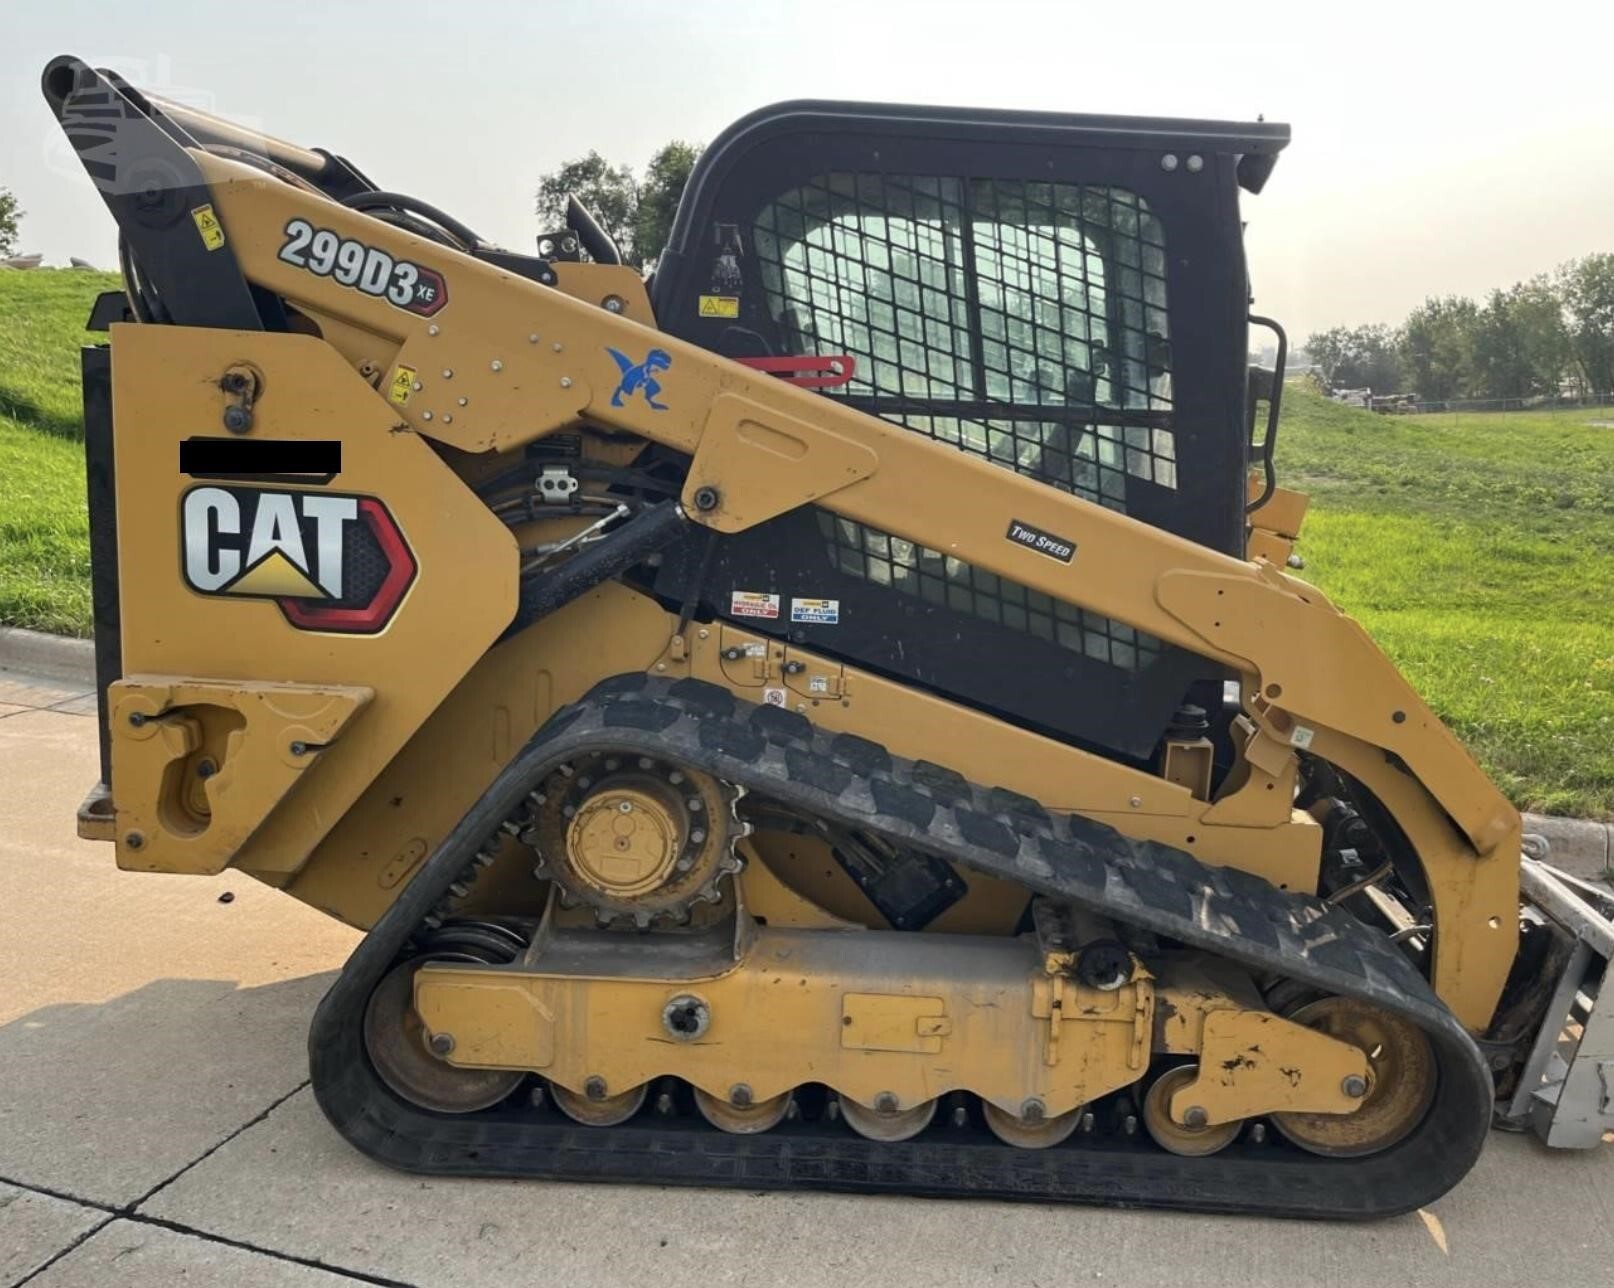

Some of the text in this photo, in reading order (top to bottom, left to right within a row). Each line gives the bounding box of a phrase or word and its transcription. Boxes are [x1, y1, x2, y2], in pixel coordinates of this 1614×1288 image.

[280, 221, 435, 305] 299D3 XE
[184, 487, 357, 599] CAT
